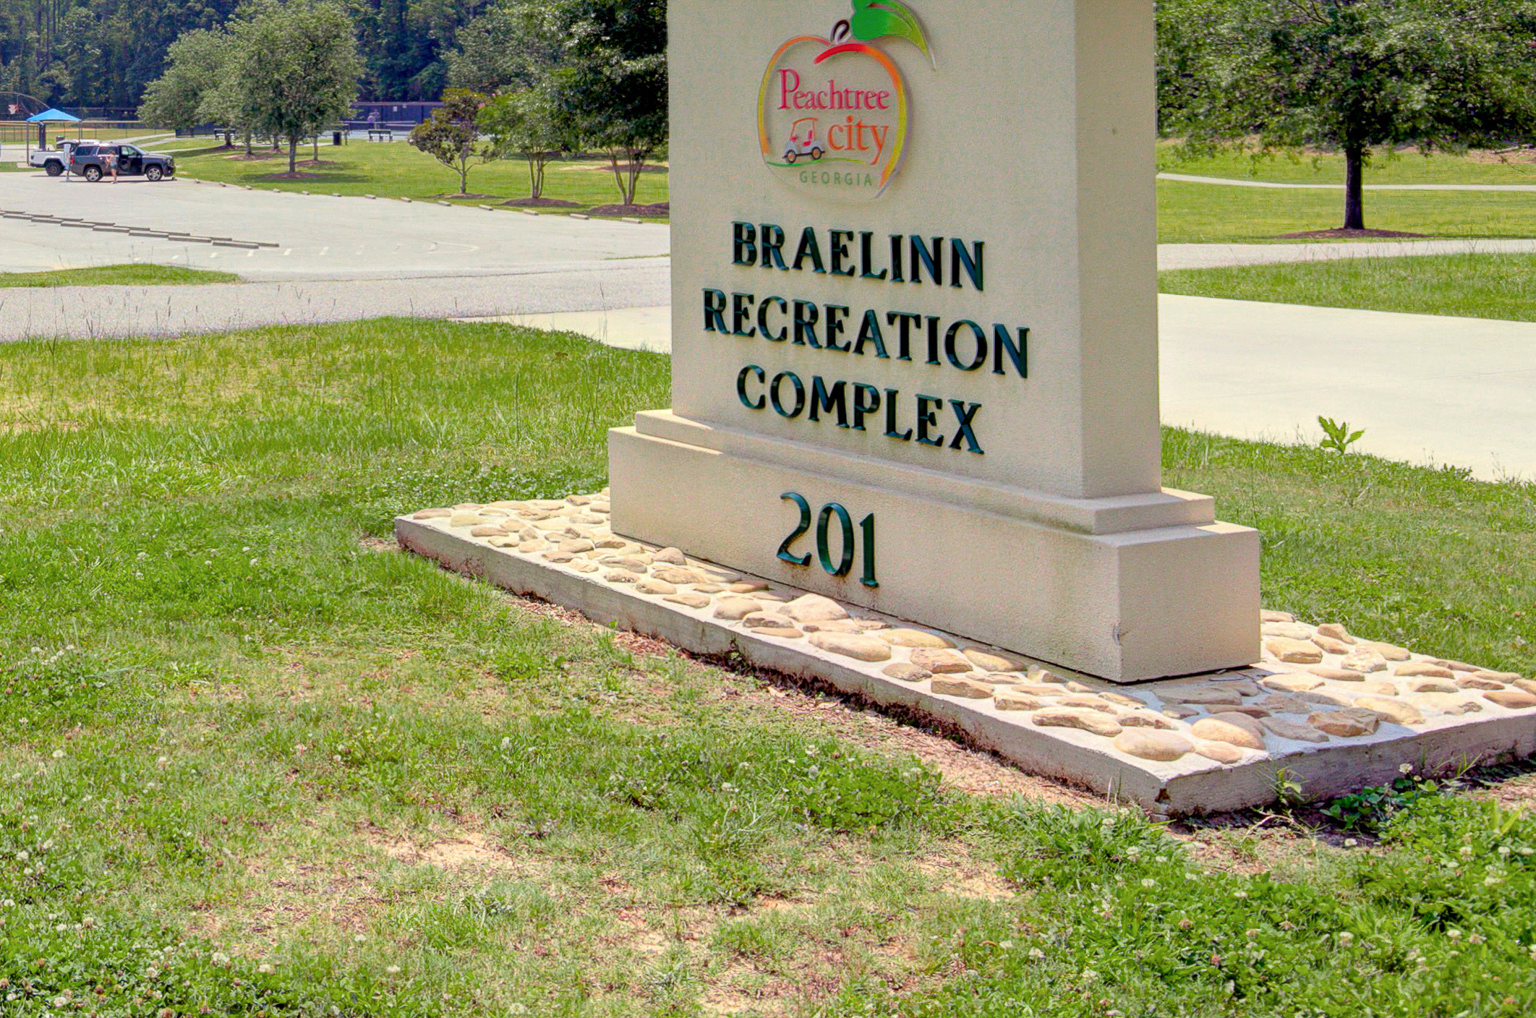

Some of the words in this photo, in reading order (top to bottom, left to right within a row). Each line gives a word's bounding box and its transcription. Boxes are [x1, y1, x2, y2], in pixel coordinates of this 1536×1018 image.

[777, 68, 890, 110] Peachtree
[827, 115, 889, 165] city
[799, 169, 873, 187] GEORGIA
[731, 220, 985, 291] BRAELINN
[702, 288, 1029, 379] RECREATION
[736, 364, 985, 454] COMPLEX
[776, 492, 879, 587] 201
